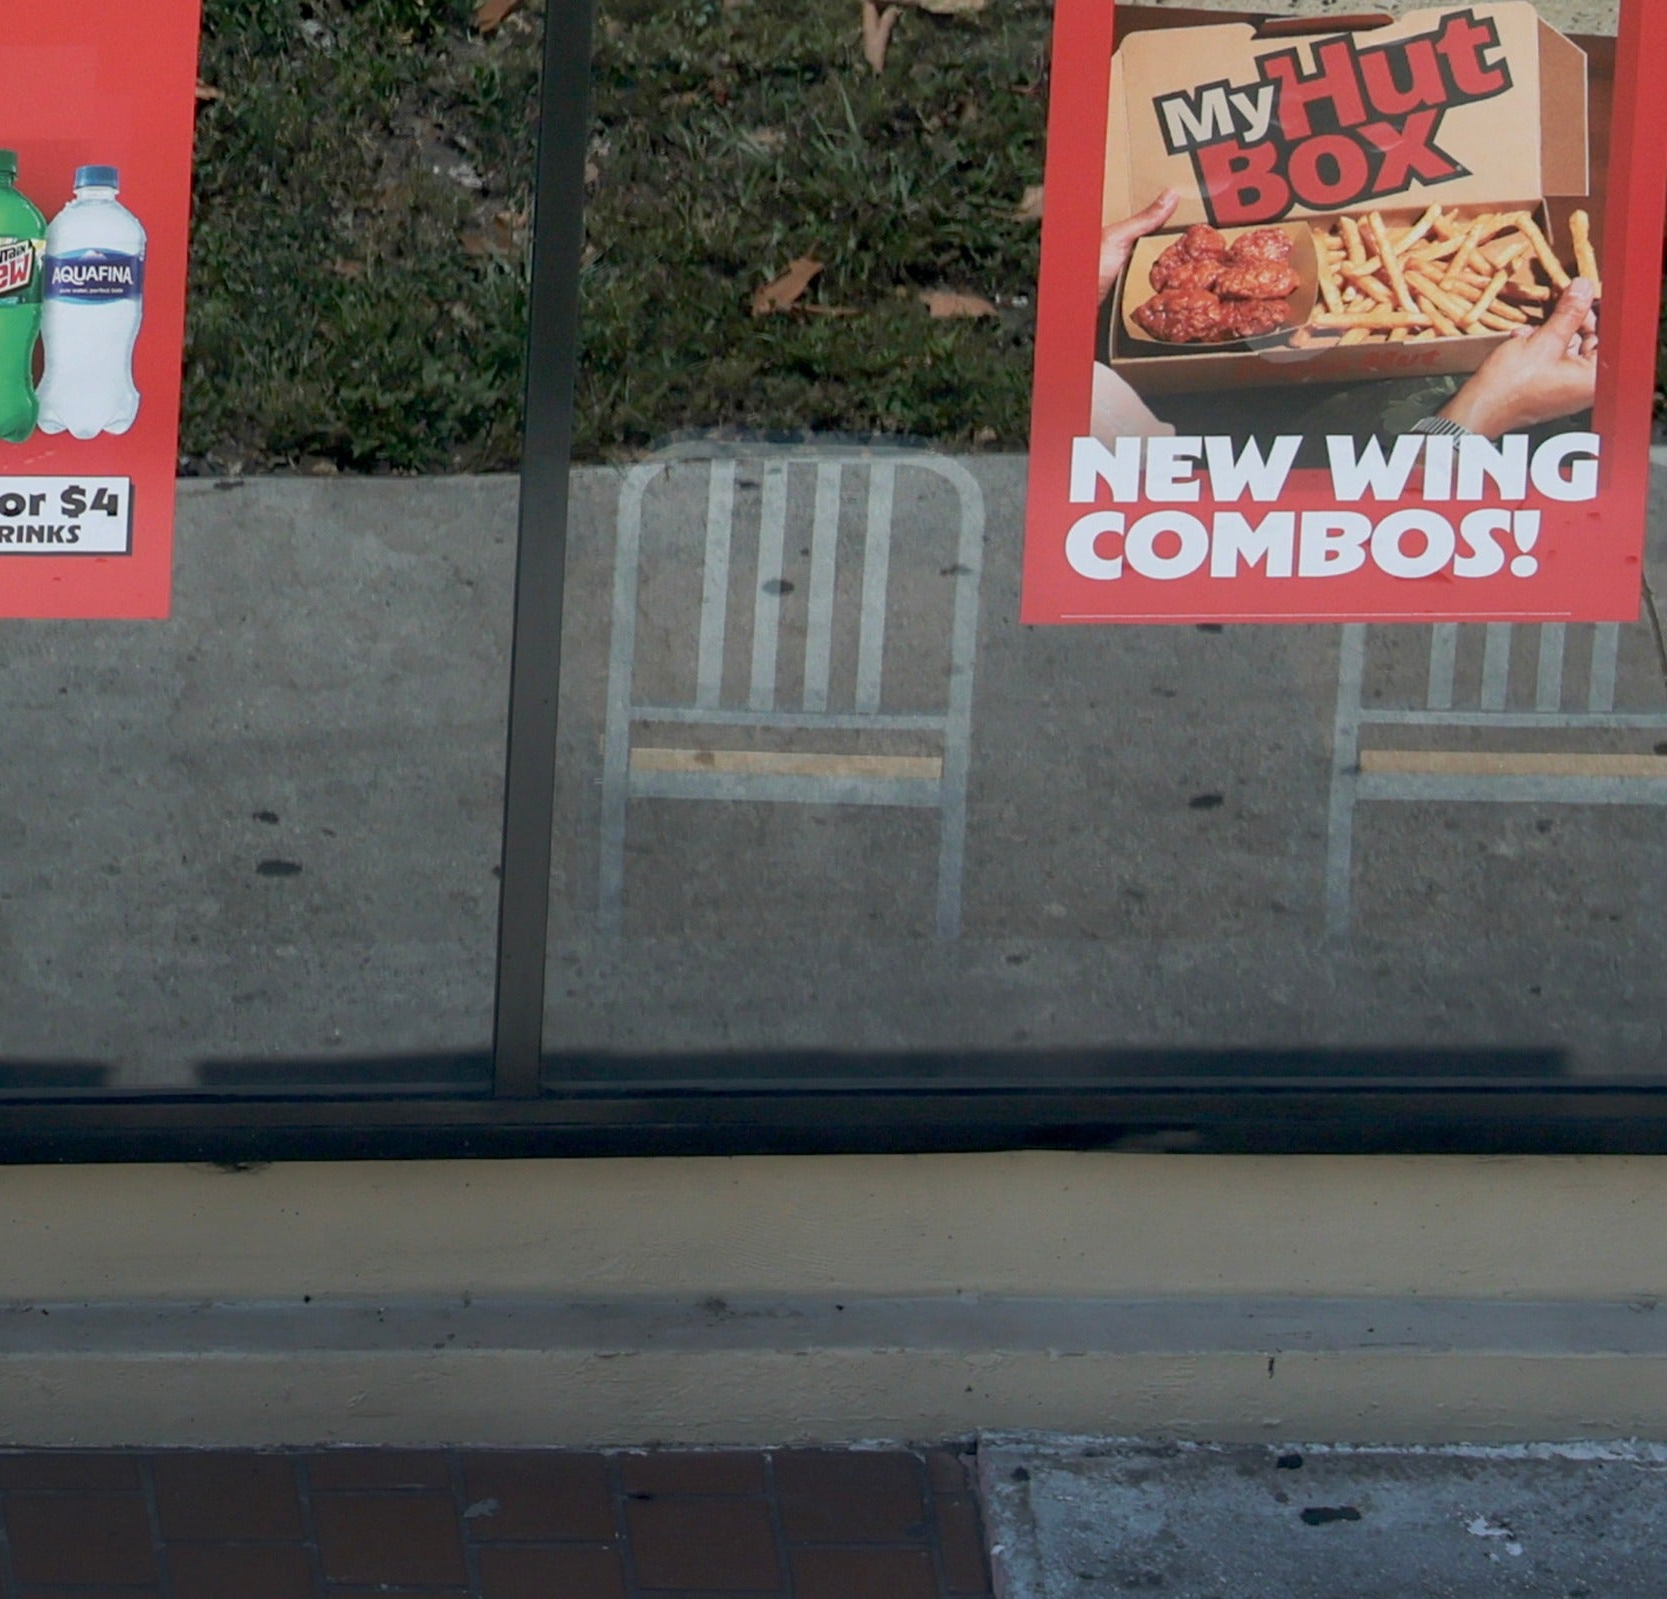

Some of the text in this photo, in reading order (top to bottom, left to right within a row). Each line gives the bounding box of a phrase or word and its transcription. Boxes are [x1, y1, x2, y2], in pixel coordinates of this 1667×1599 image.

[51, 265, 135, 286] AQUAFINA
[1069, 432, 1601, 504] NEW WING
[61, 485, 119, 518] $4
[1065, 508, 1542, 580] COMBOS!
